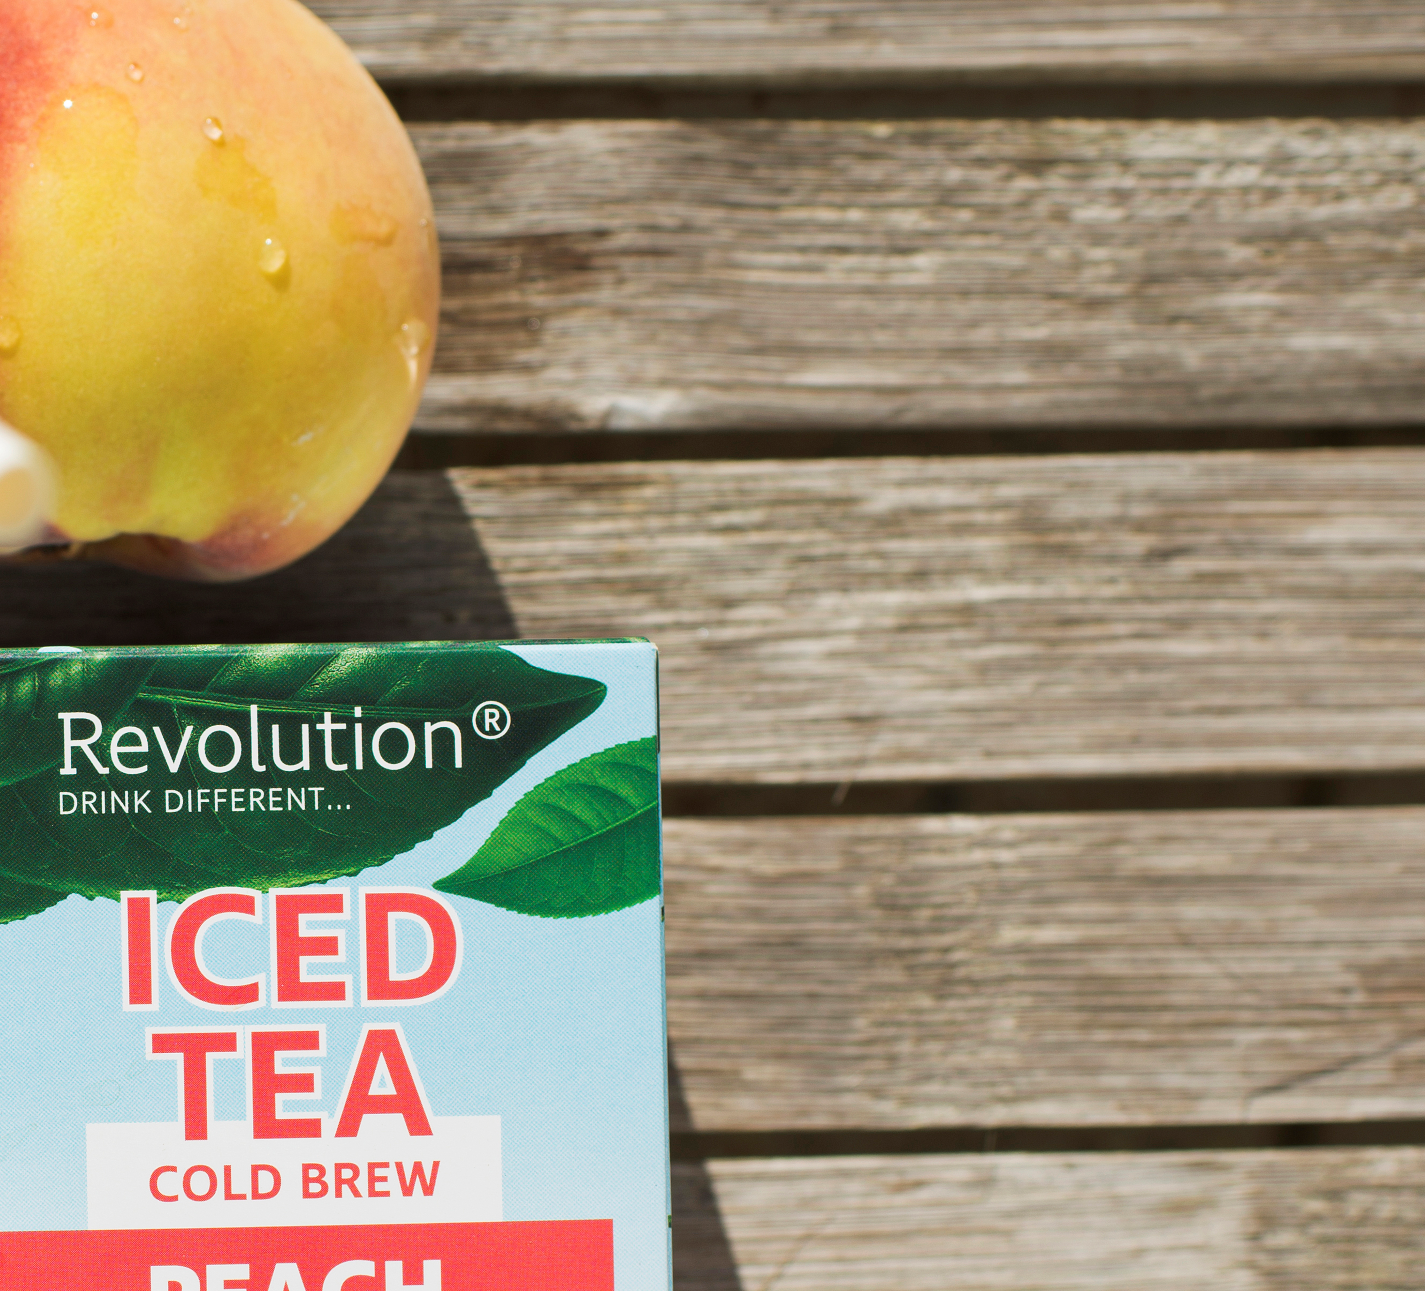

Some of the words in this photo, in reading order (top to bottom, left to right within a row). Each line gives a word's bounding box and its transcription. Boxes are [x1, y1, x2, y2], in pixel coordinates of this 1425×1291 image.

[60, 790, 151, 814] DRINK
[121, 887, 463, 1010] ICED
[146, 1023, 437, 1141] TEA
[150, 1164, 281, 1202] COLD
[302, 1161, 439, 1198] BREW
